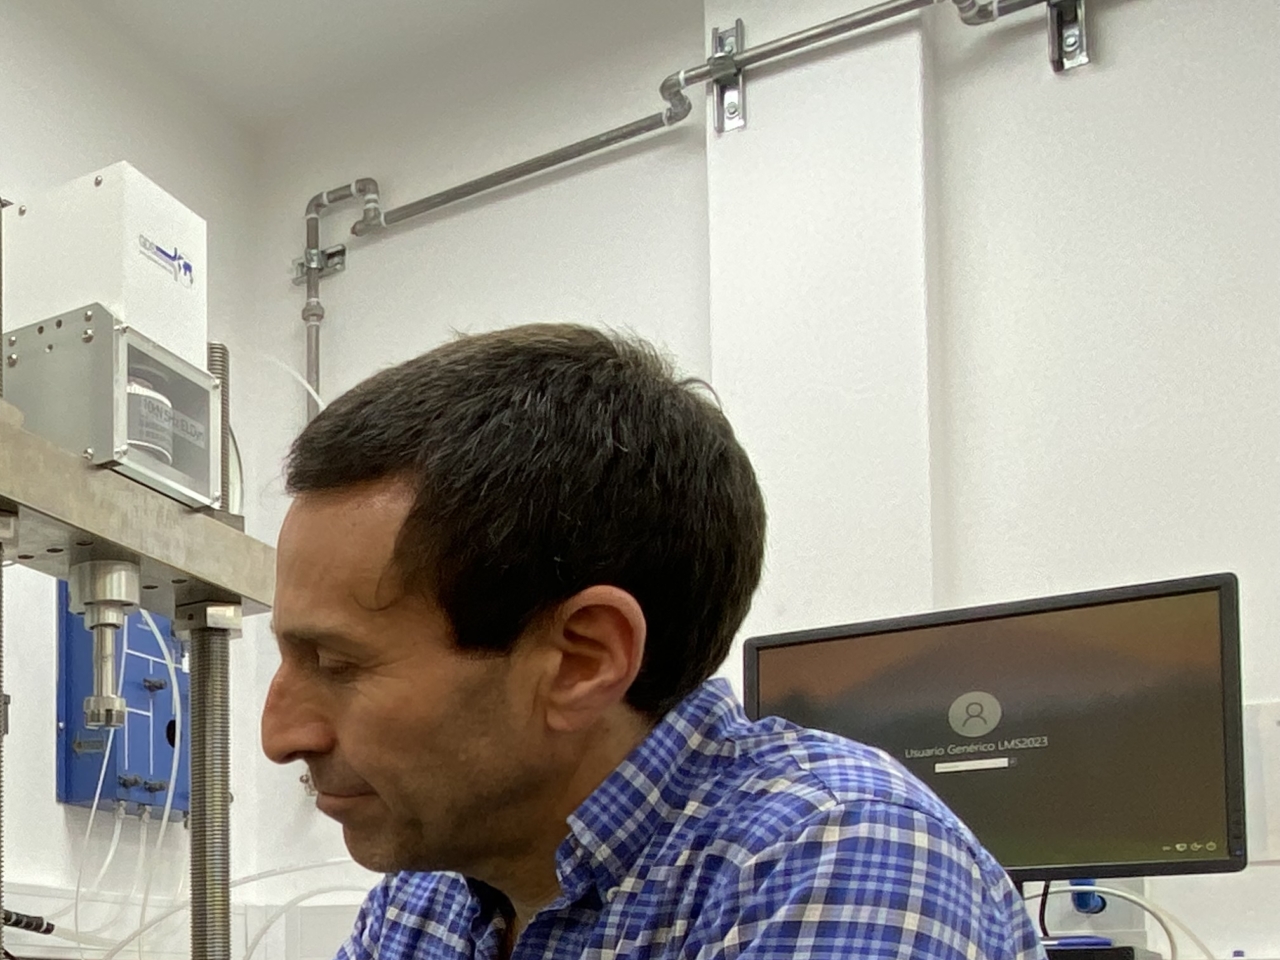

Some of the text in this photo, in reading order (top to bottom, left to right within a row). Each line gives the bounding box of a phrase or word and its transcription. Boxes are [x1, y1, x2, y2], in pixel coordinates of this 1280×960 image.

[904, 736, 1048, 759] Usuario Genérico LMS2023
